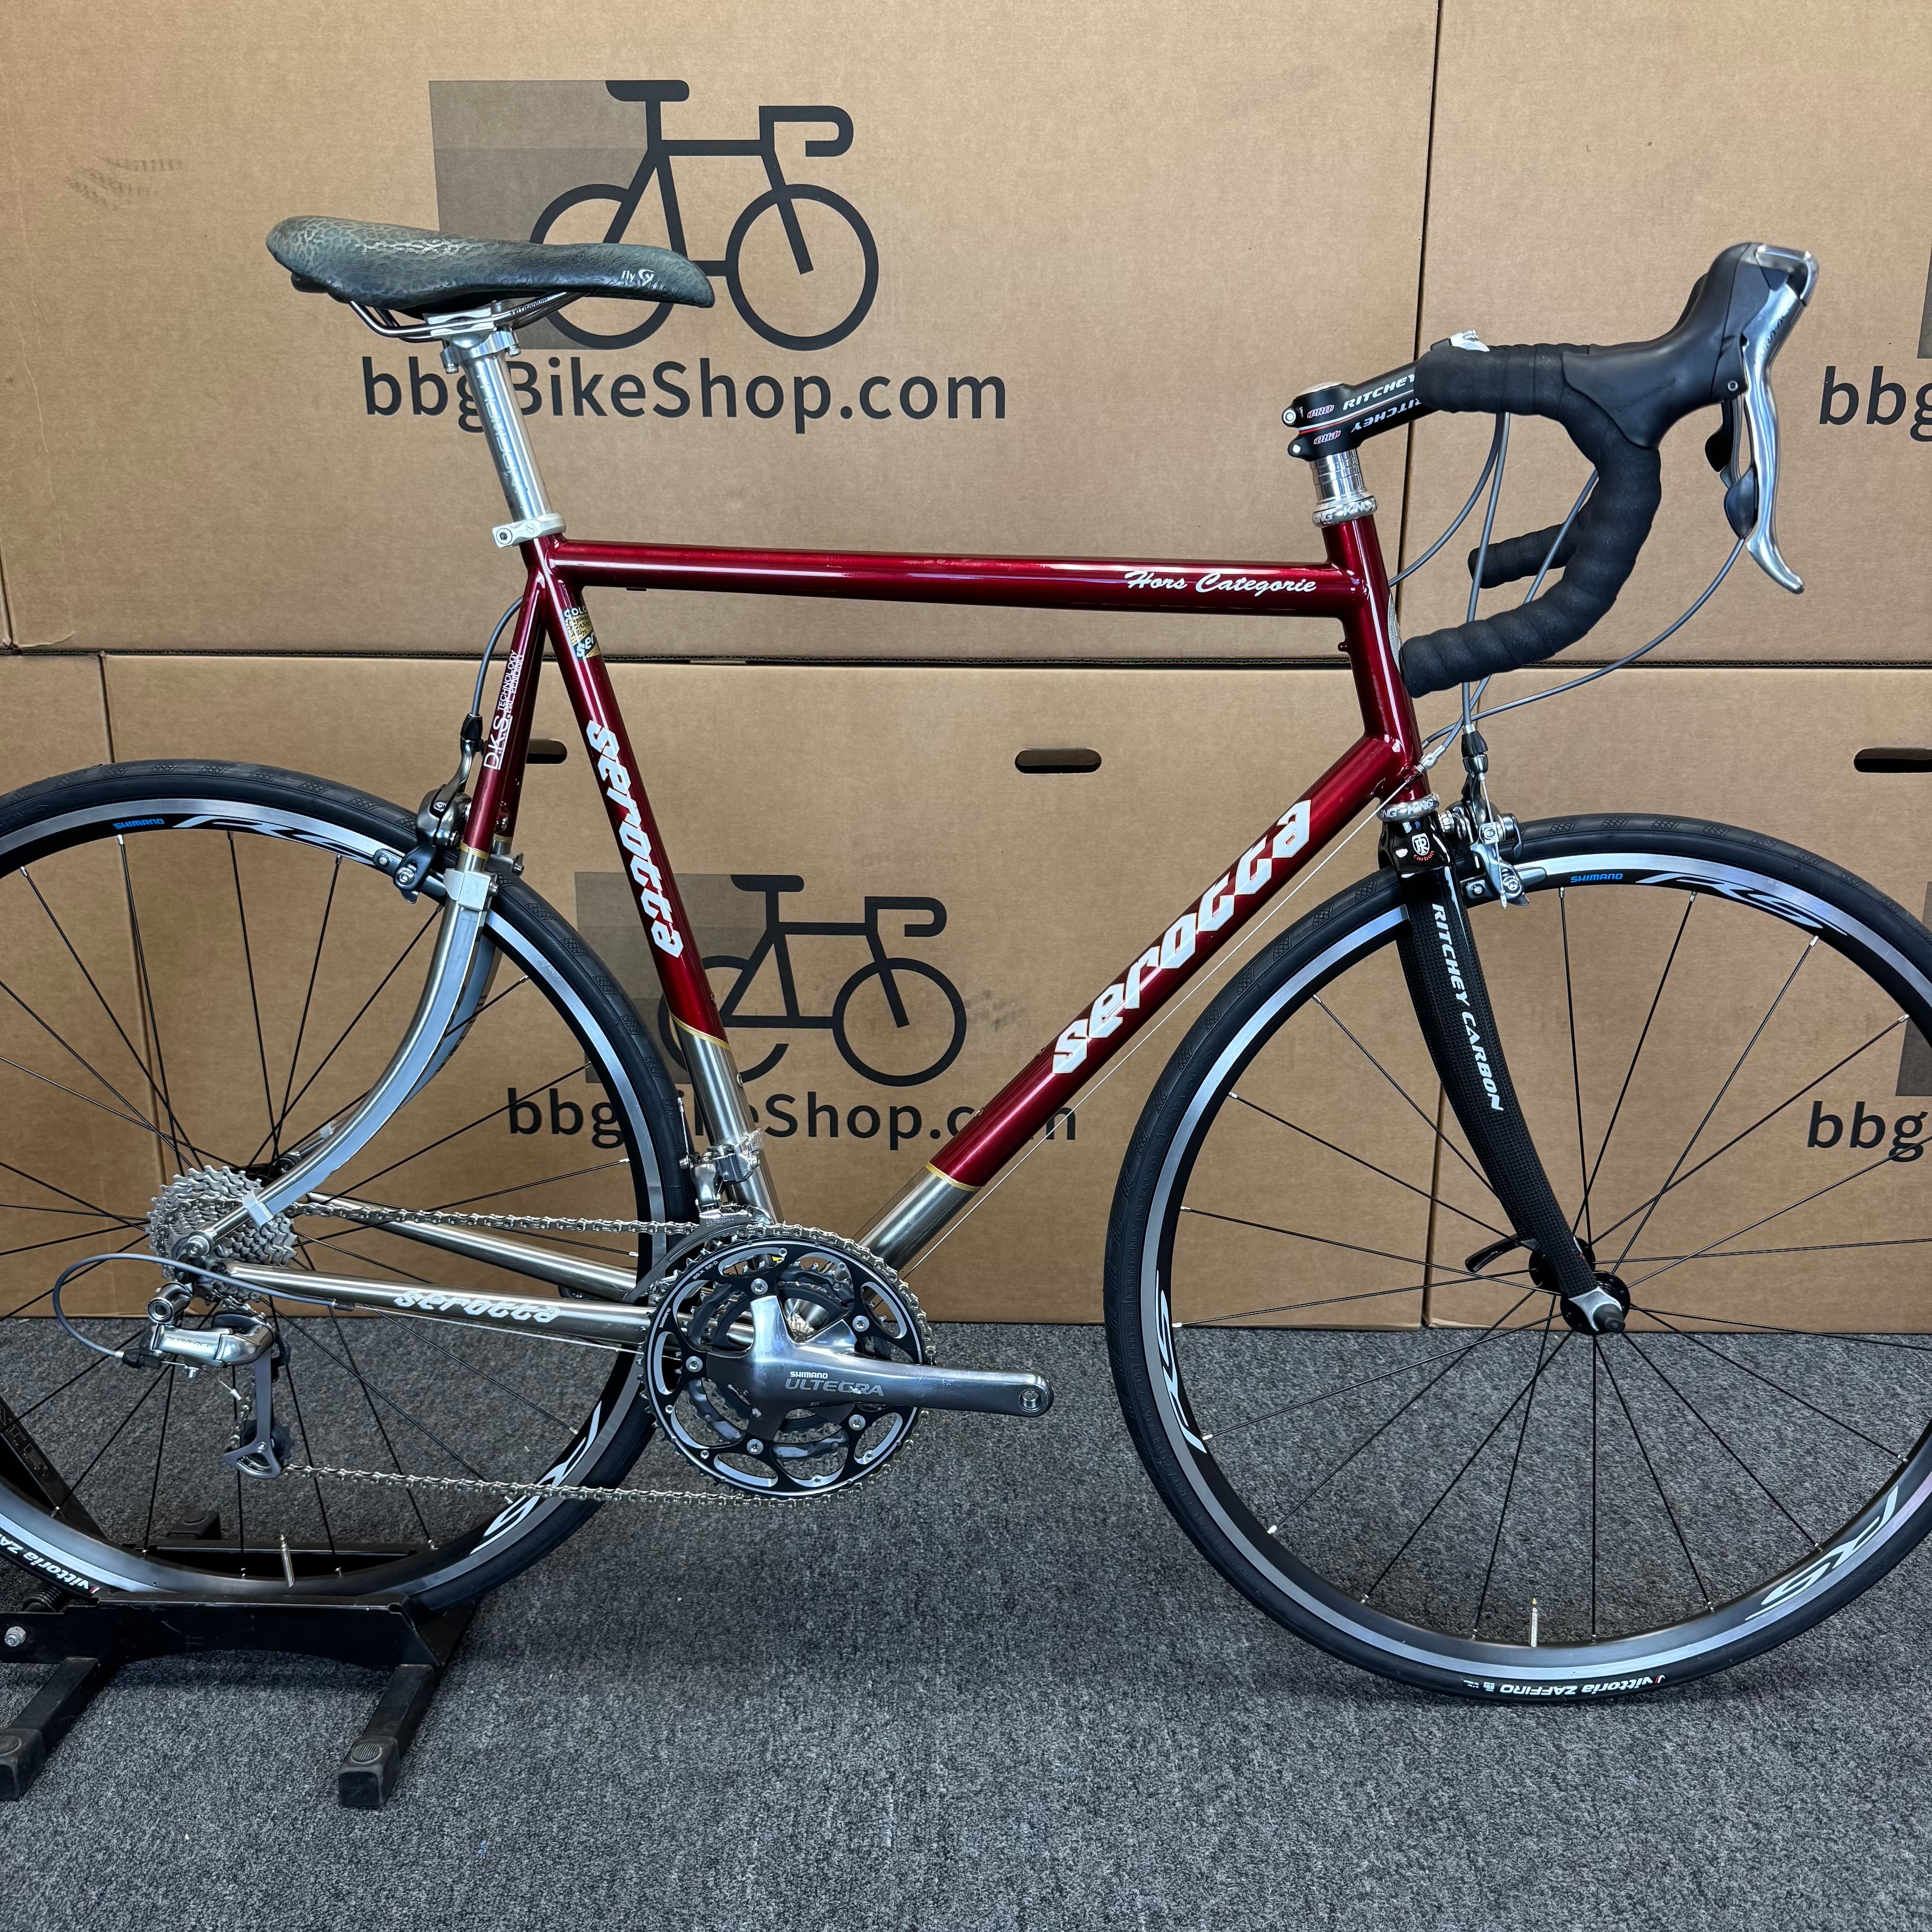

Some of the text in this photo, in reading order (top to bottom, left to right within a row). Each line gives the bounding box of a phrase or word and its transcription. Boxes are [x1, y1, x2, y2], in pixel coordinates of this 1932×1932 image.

[622, 271, 635, 281] fly
[1307, 405, 1334, 419] PRO
[1314, 430, 1341, 445] PRO
[1124, 570, 1317, 597] Hors Categorie
[497, 649, 518, 711] TECHNOLOGY
[511, 654, 524, 694] PENDING
[1407, 798, 1434, 815] KING
[113, 818, 165, 829] SHIMANO
[586, 720, 684, 958] serotta
[1413, 851, 1435, 862] carbon
[1570, 872, 1624, 883] SHIMANO
[1052, 799, 1312, 1074] serotta
[1431, 903, 1504, 1112] RITCHEY CARBON
[1165, 1070, 1200, 1124] ROTATION
[1134, 1204, 1145, 1221] ON
[1129, 1225, 1140, 1255] ONLY
[1124, 1260, 1136, 1299] MOUNT
[393, 1289, 564, 1323] serotta
[659, 1307, 671, 1328] SHIMANO
[790, 1371, 828, 1379] SHIMANO
[785, 1378, 885, 1397] ULTEGRA
[0, 1534, 89, 1590] vittoria ZA
[1500, 1684, 1578, 1696] ZAFFIRO
[1581, 1676, 1654, 1694] vittoria
